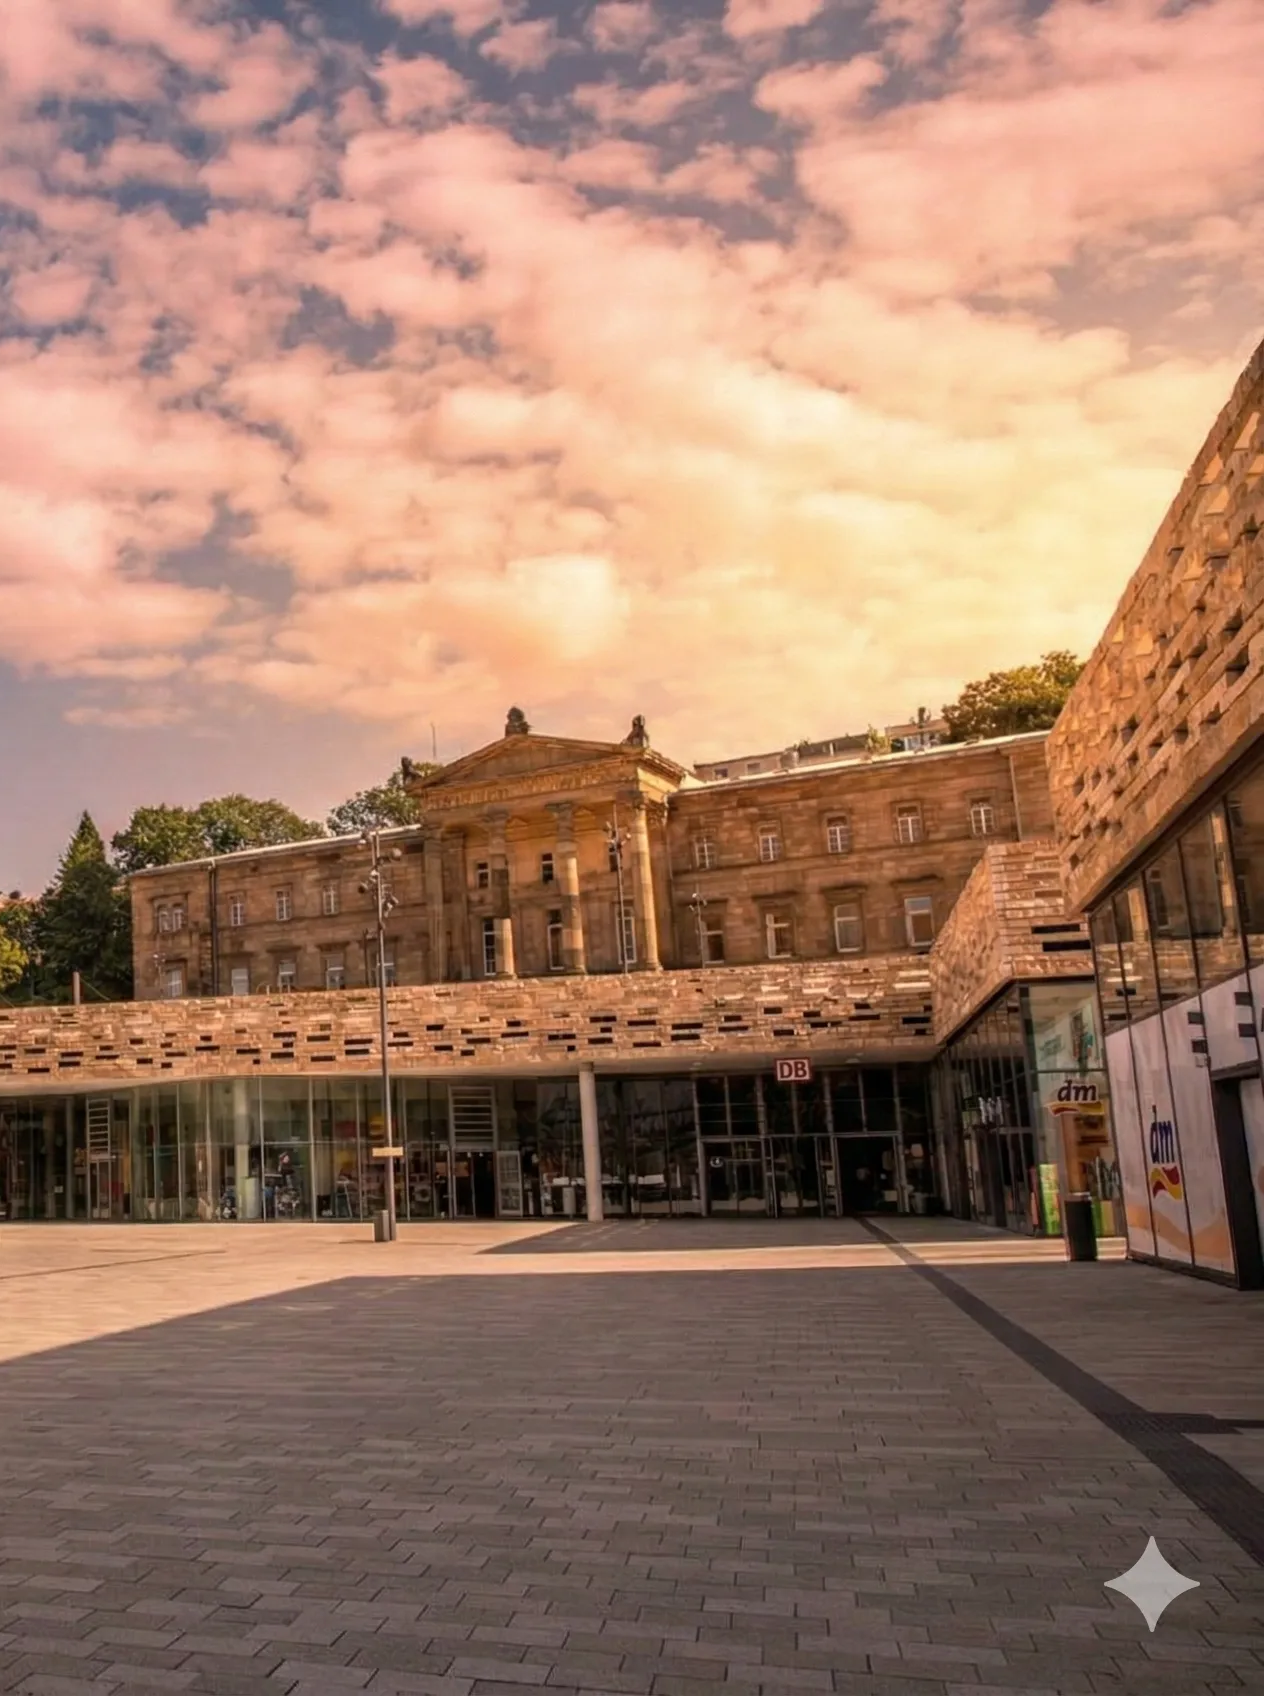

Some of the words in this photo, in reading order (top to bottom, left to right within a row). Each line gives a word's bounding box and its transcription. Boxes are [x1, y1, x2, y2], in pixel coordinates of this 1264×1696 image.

[780, 1061, 807, 1079] DB
[1058, 1080, 1097, 1101] dm
[1150, 1105, 1174, 1164] dm
